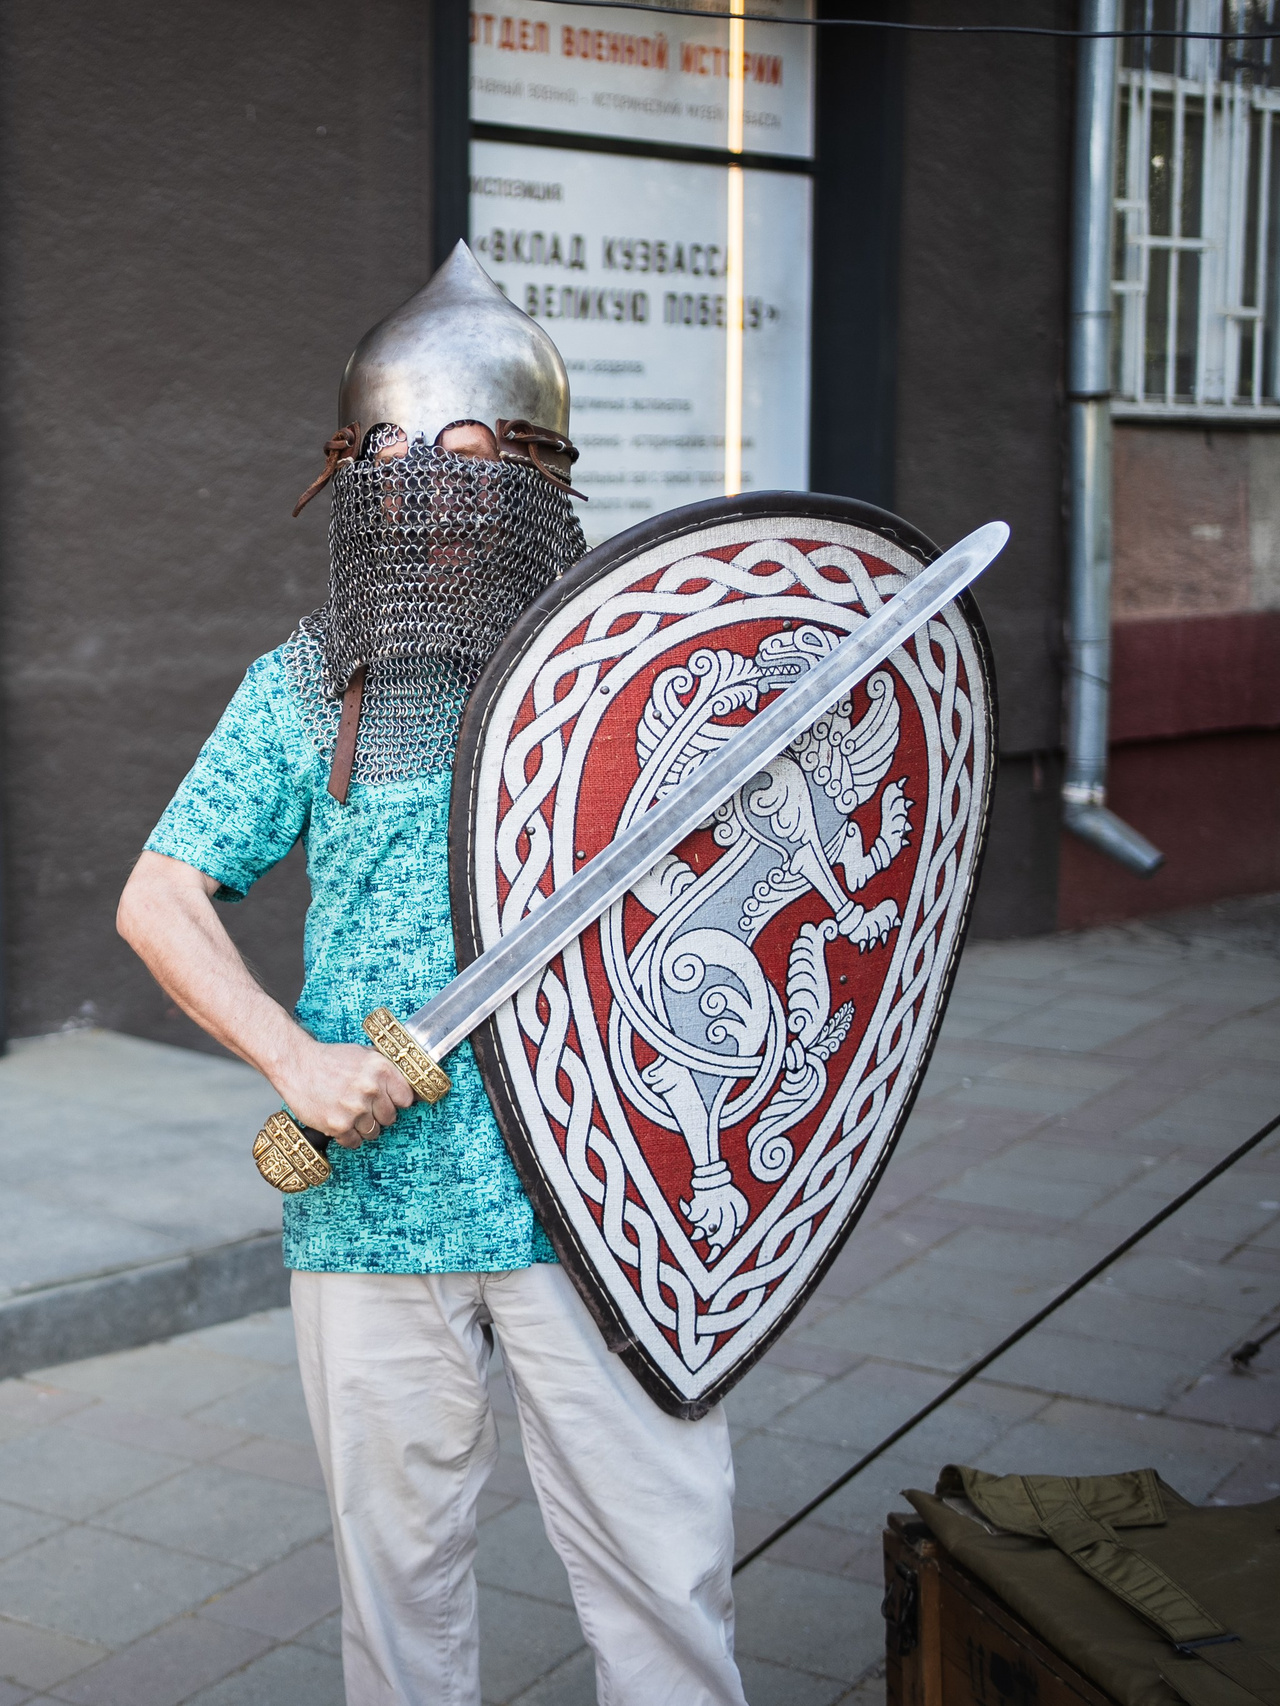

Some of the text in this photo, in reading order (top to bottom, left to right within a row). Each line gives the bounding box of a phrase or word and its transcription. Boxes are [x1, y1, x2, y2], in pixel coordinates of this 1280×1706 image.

[561, 25, 669, 72] ВОЕННОЙ
[680, 42, 783, 88] ИСТРИИ
[470, 175, 564, 203] КСПОЗИЦИЯ
[526, 282, 650, 325] ВЕЛИКУЮ
[663, 290, 781, 331] ПОБЕУ»
